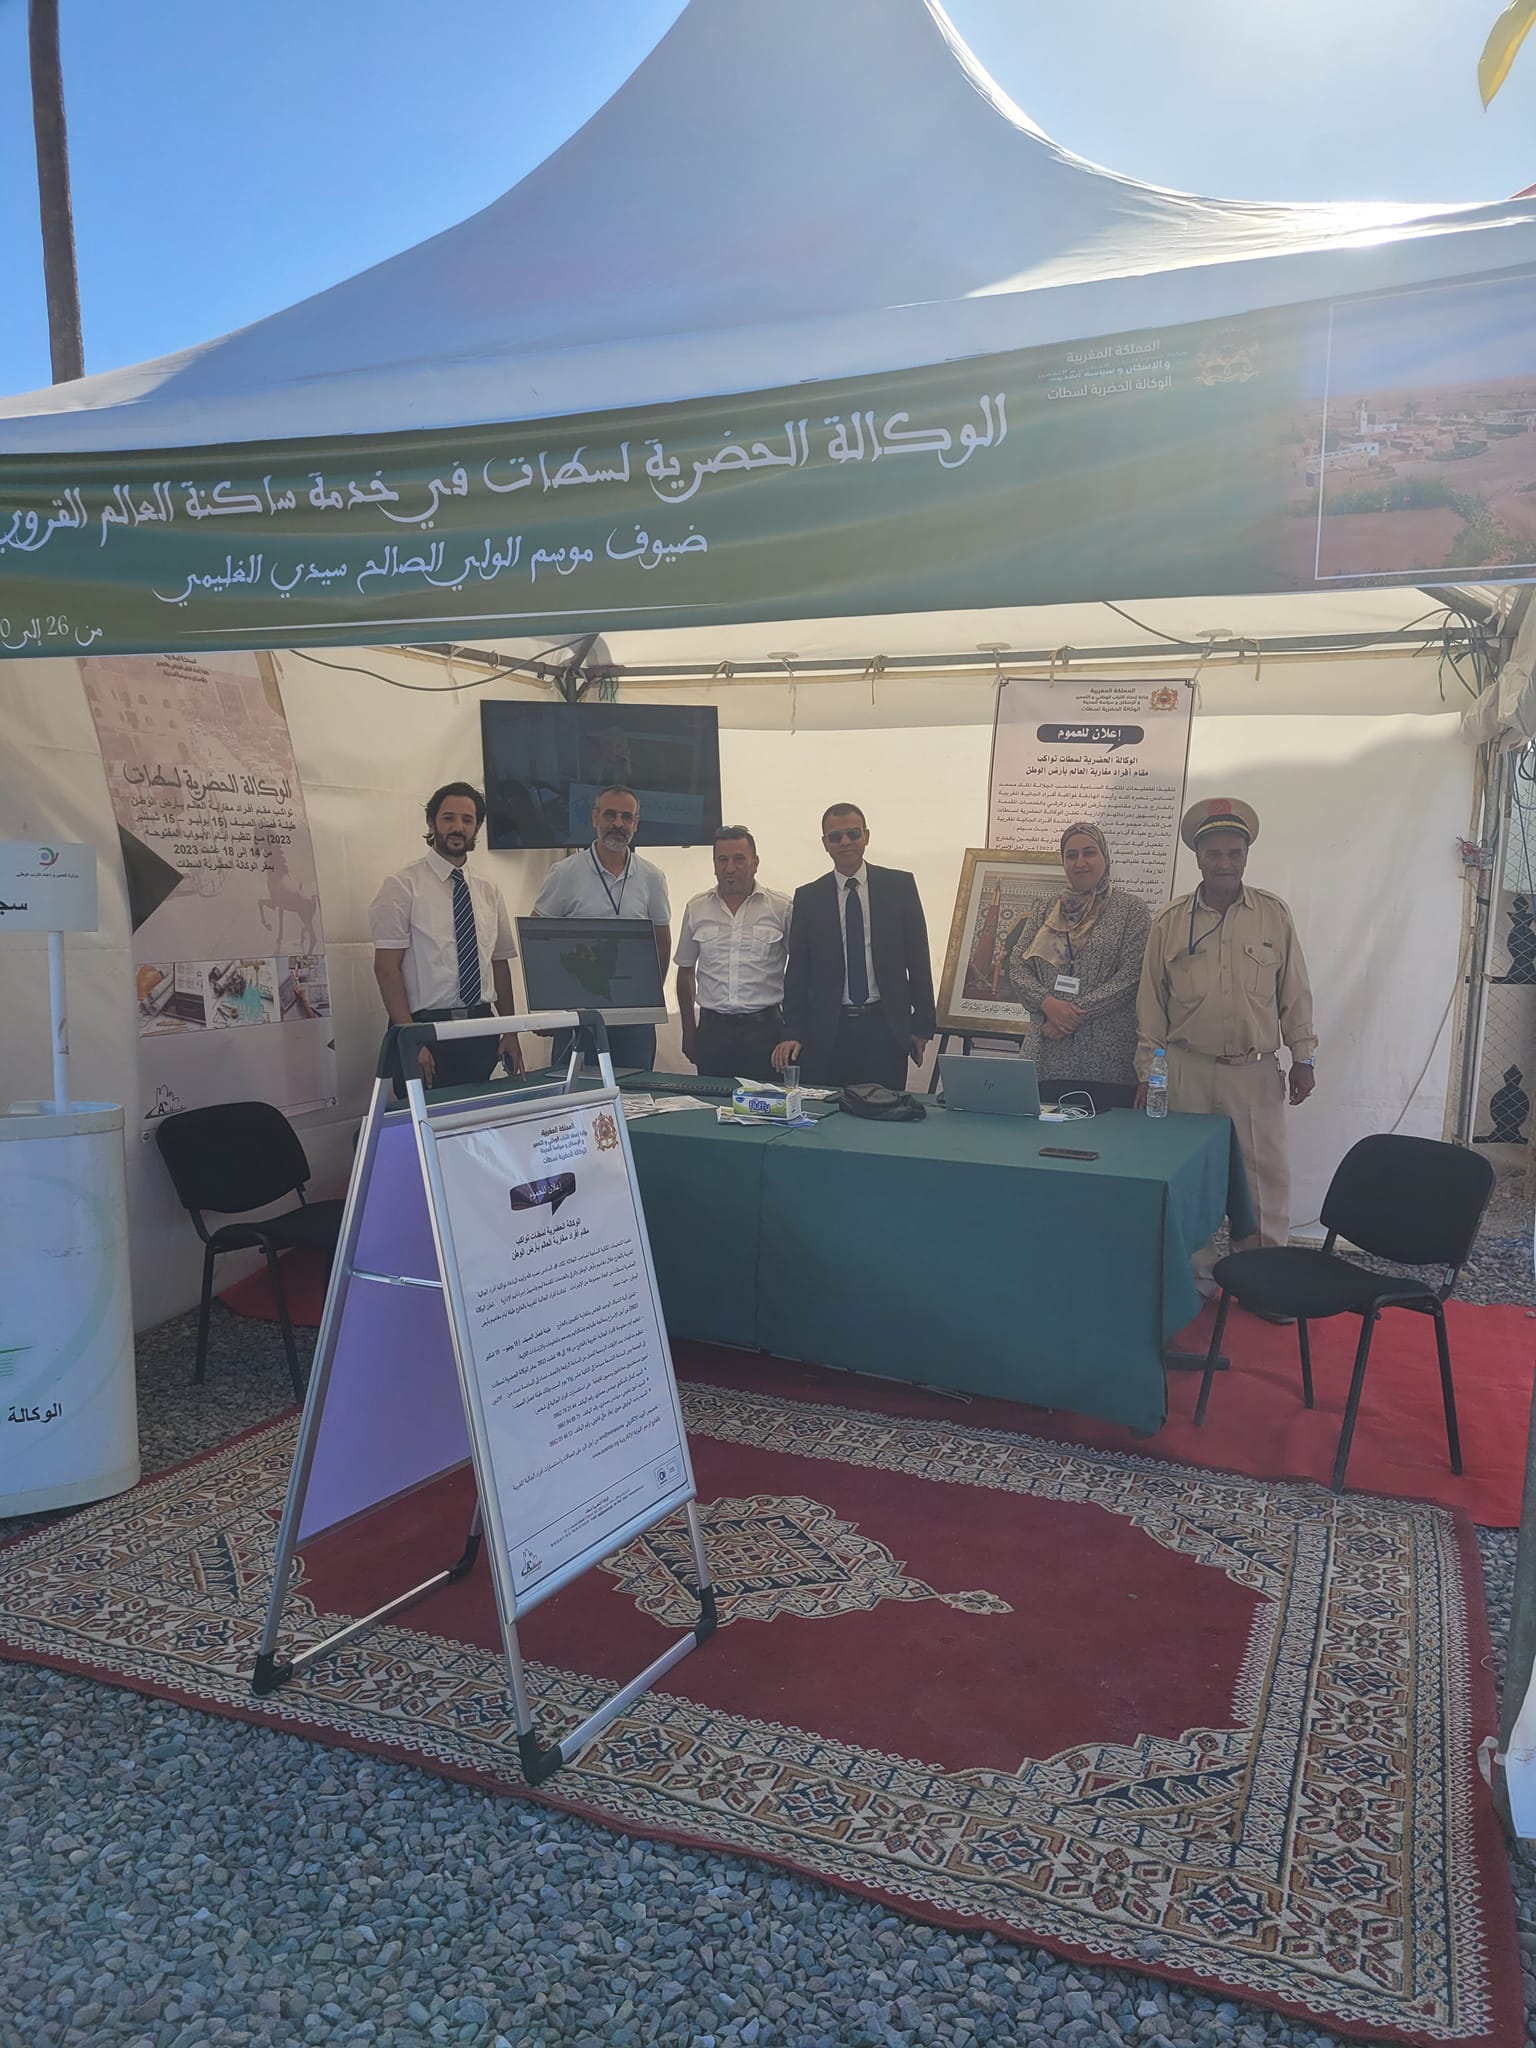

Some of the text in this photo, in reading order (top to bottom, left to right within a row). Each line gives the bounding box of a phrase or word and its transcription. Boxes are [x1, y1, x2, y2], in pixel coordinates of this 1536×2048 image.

[826, 392, 1007, 468] الوكالة
[483, 439, 630, 494] لسطات
[645, 417, 810, 503] الحضرية
[183, 475, 297, 520] ساكنة
[308, 469, 399, 511] خدمة
[375, 460, 468, 530] في
[99, 480, 175, 548] العالم
[357, 540, 447, 594] الصالح
[423, 535, 522, 590] الولي
[531, 543, 594, 583] موسم
[606, 523, 708, 570] ضيوف
[270, 561, 348, 599] سيدي
[46, 615, 69, 636] 26
[74, 625, 103, 647] من
[1057, 726, 1121, 741] إعلان للعموم
[1058, 753, 1082, 763] لسطات
[1083, 754, 1113, 765] الحضرية
[1115, 755, 1138, 766] الوكالة
[123, 763, 292, 805] الوكالة الحضرية لسطات
[174, 844, 198, 855] 2023
[8, 1402, 62, 1424] الوكالة
